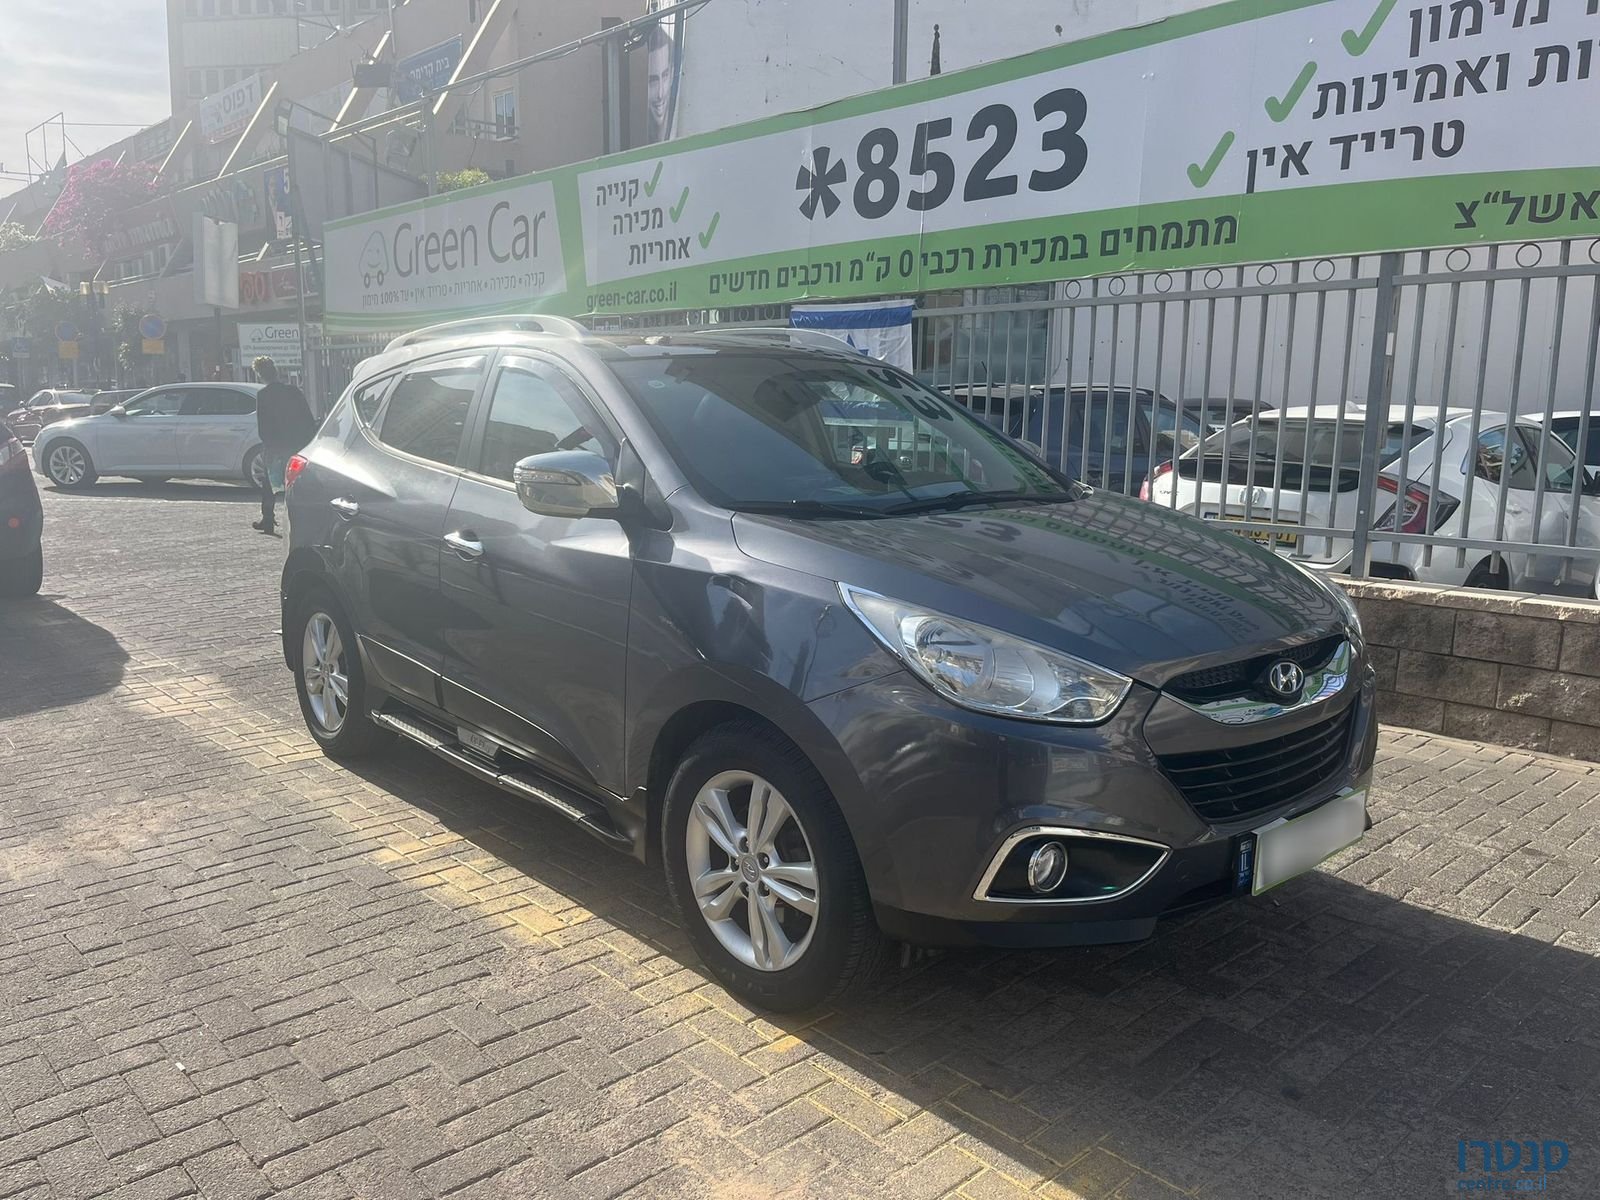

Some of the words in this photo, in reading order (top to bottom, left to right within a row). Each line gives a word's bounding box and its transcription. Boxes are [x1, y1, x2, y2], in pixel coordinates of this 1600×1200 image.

[1409, 0, 1550, 58] מימון
[1527, 39, 1600, 87] ות
[222, 83, 255, 115] דפוס
[1312, 52, 1511, 120] ואמינות
[1329, 119, 1465, 171] טרייד
[1245, 140, 1314, 194] אין
[596, 178, 640, 207] קנייה
[613, 207, 664, 236] מכירה
[1100, 215, 1238, 257] מתמחים
[393, 222, 478, 278] Green
[487, 201, 546, 263] Car
[628, 236, 691, 266] אחריות
[982, 233, 1089, 270] במכירת
[776, 261, 842, 289] ורכבים
[900, 249, 914, 278] 0
[920, 247, 975, 275] רכבי
[454, 279, 483, 297] אחריות
[490, 275, 516, 291] מכירה
[586, 281, 678, 312] green-car.co.il
[709, 269, 770, 295] חדשים
[380, 290, 400, 305] 100%
[264, 326, 299, 339] Green
